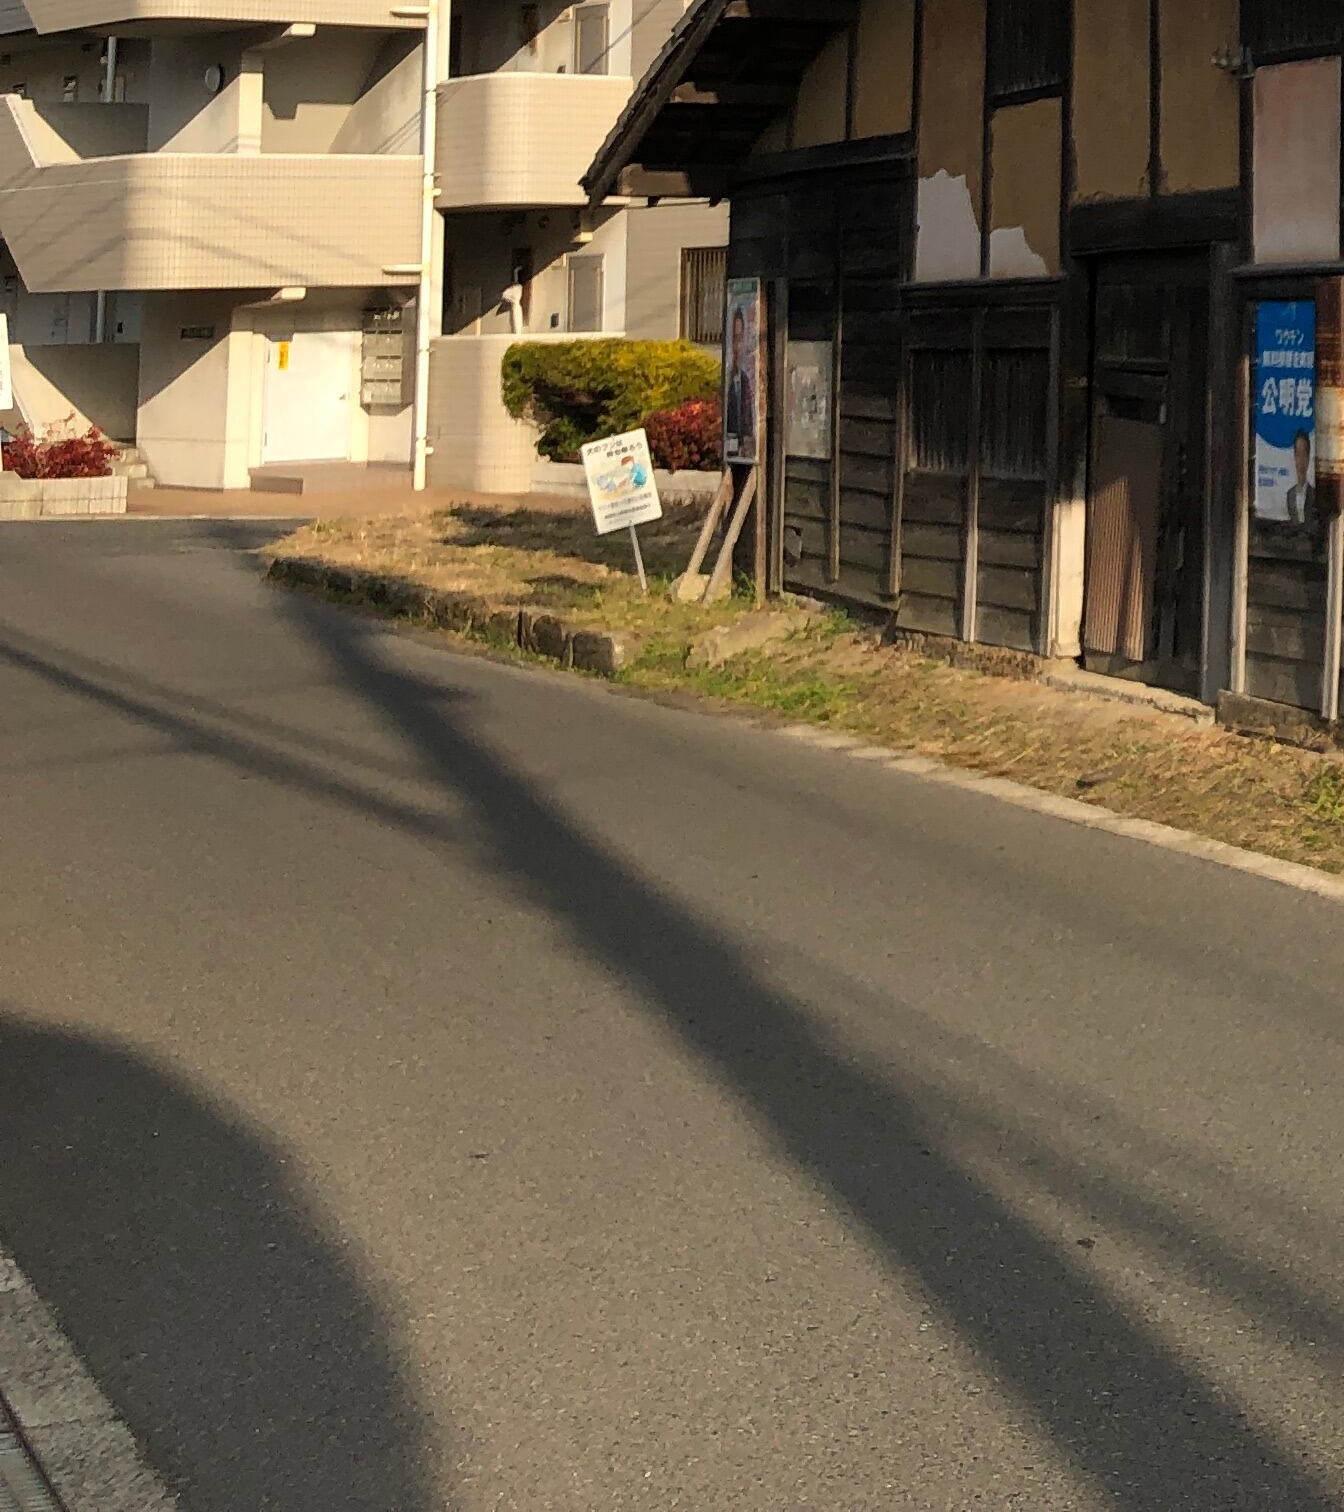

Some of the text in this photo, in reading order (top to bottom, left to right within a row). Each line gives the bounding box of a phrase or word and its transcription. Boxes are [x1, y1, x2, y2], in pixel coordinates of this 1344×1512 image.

[1274, 329, 1304, 345] ワクチン
[1261, 377, 1313, 418] 公明党
